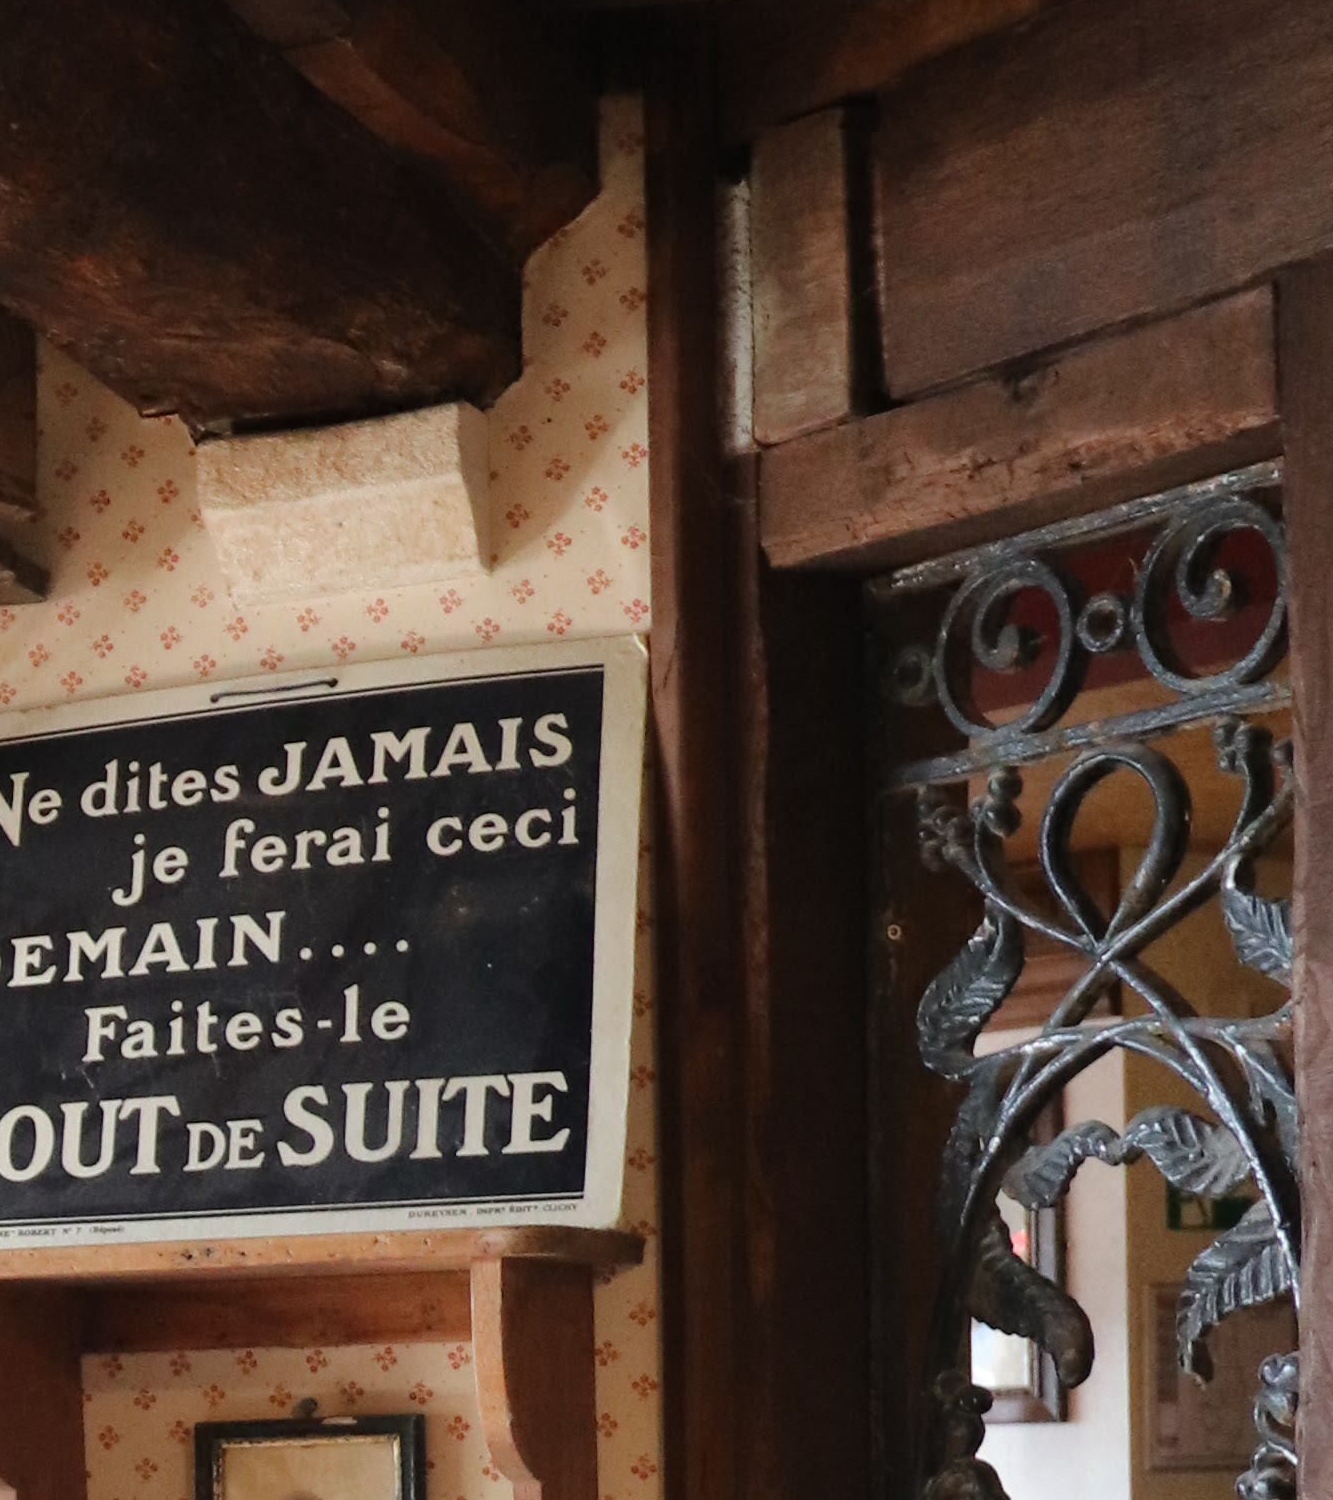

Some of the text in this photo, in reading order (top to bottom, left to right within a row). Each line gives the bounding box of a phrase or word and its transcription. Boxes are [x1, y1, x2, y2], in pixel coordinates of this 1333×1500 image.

[80, 757, 242, 818] dites
[257, 712, 574, 797] JAMAIS
[111, 786, 581, 907] je ferai ceci
[81, 982, 412, 1062] Faites-le
[182, 1118, 266, 1173] DE
[276, 1070, 572, 1168] SUITE
[17, 1227, 56, 1237] ROBERT
